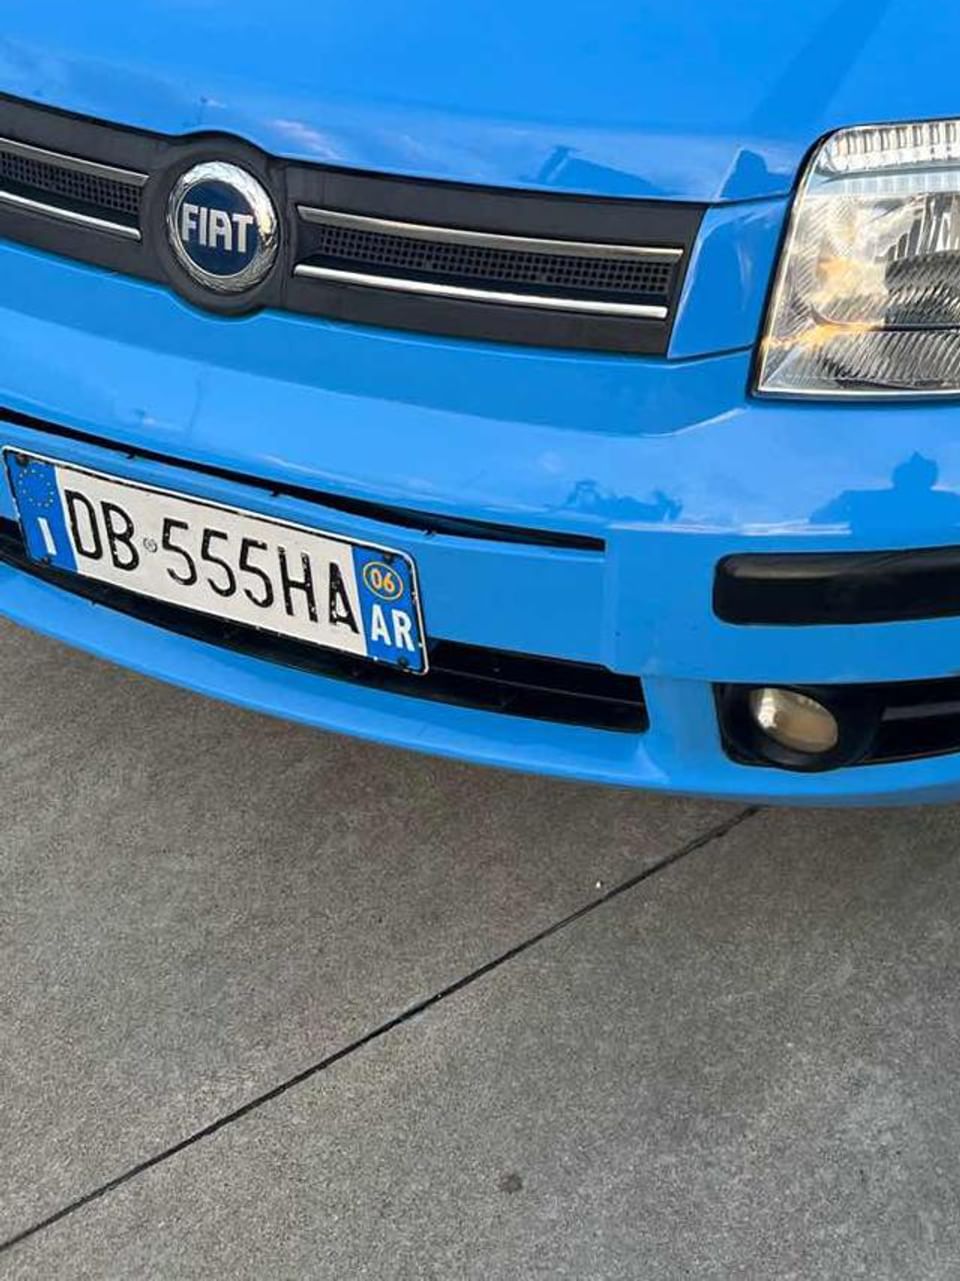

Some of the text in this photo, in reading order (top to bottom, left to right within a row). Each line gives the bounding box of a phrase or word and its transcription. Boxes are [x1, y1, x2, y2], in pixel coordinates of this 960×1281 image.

[182, 203, 254, 253] FIAT
[161, 518, 360, 635] 555HA
[371, 569, 396, 594] 06
[370, 604, 416, 652] AR
